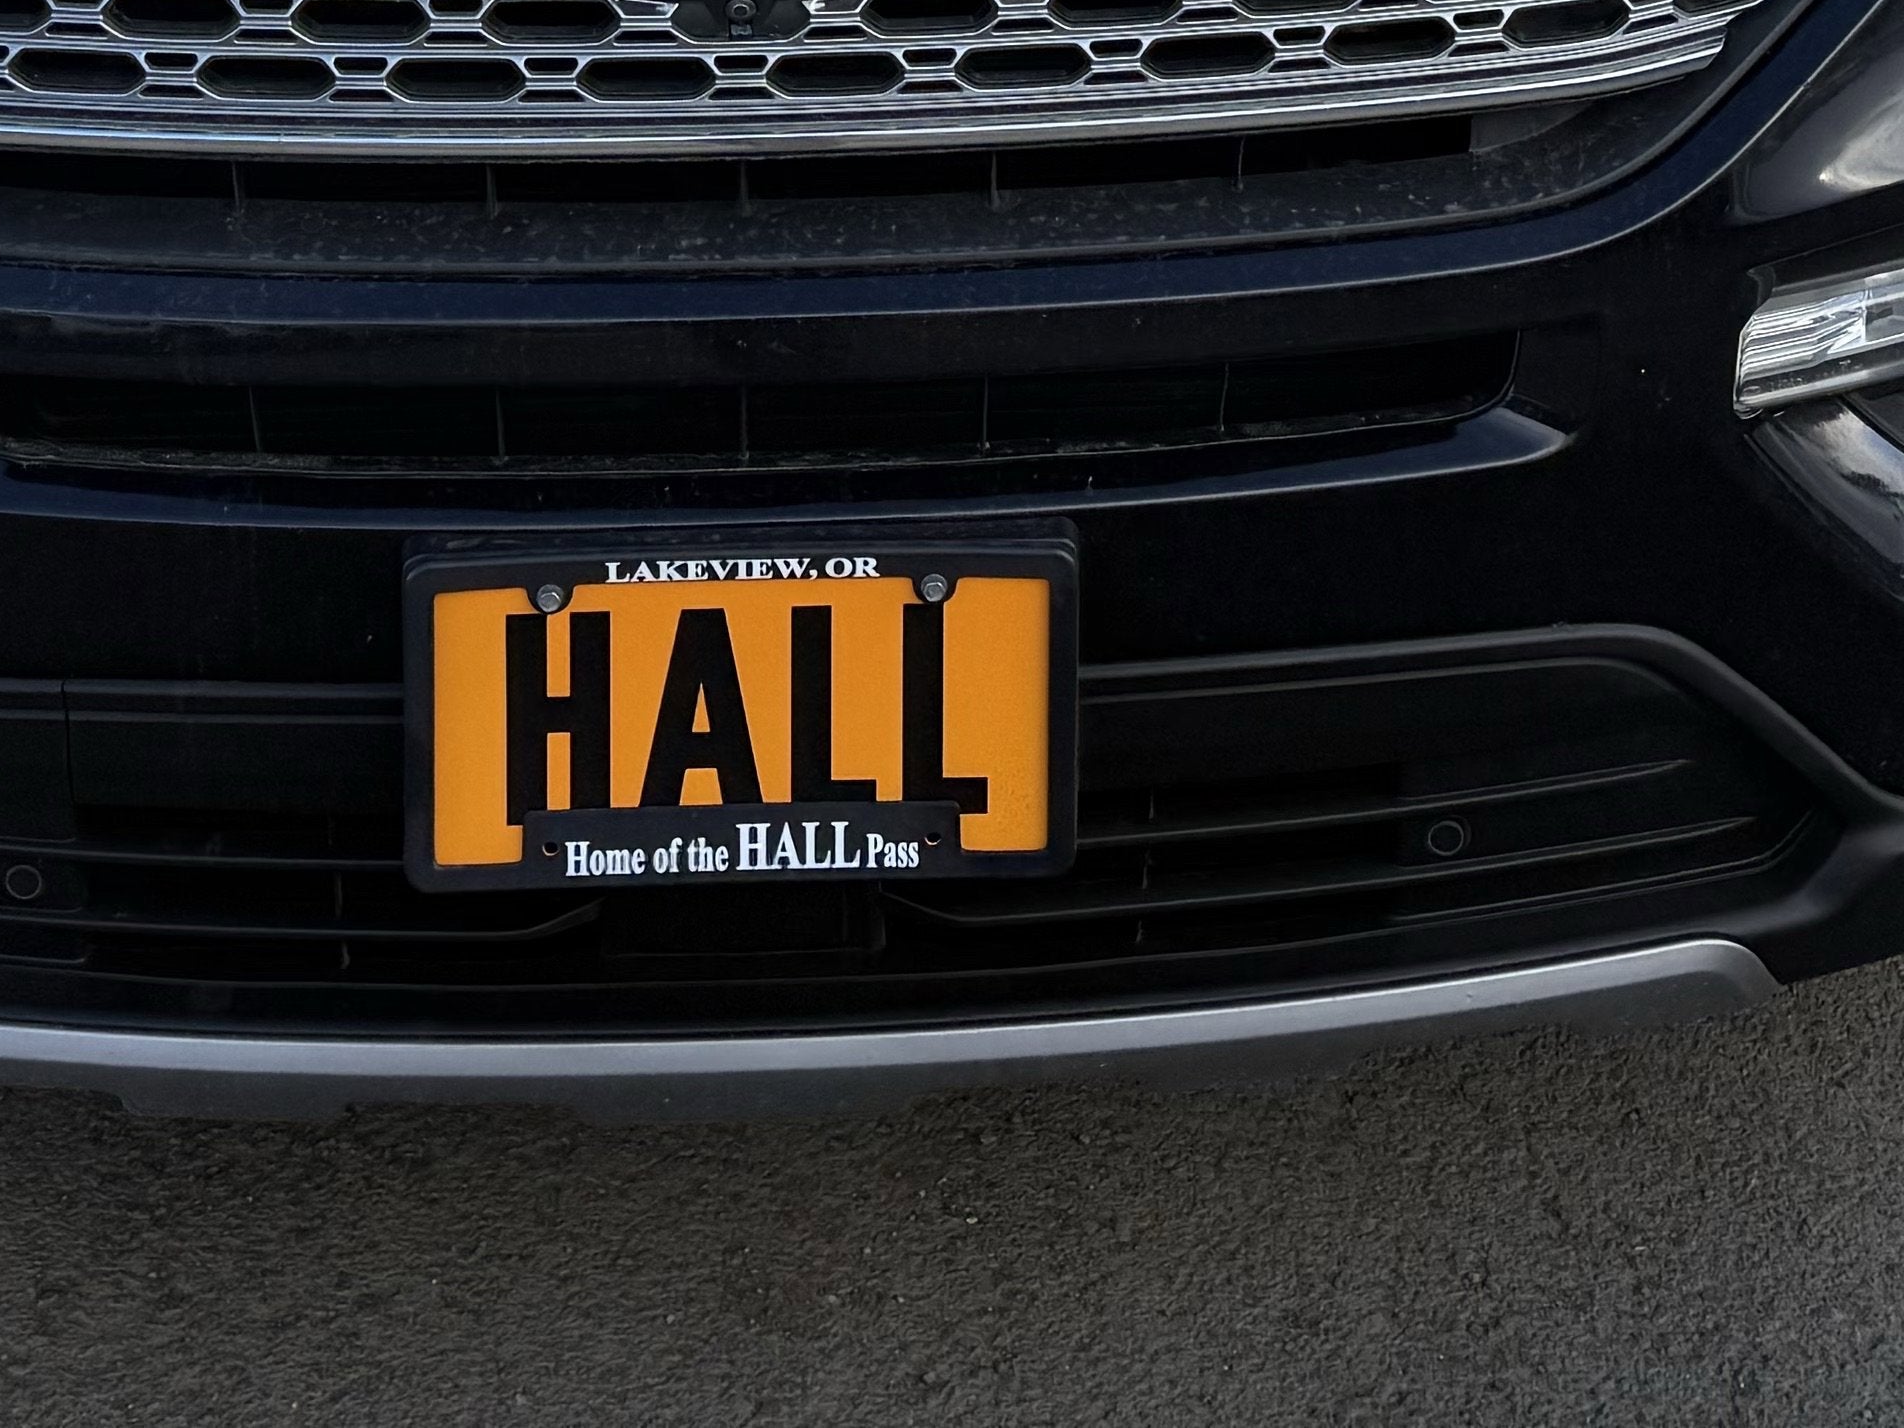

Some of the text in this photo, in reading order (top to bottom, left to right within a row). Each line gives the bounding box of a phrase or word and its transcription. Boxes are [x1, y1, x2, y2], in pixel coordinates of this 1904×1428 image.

[605, 556, 881, 583] LAKEVIEW, OR
[506, 604, 989, 826] HALL
[565, 821, 920, 877] Home of the HALL Pass
